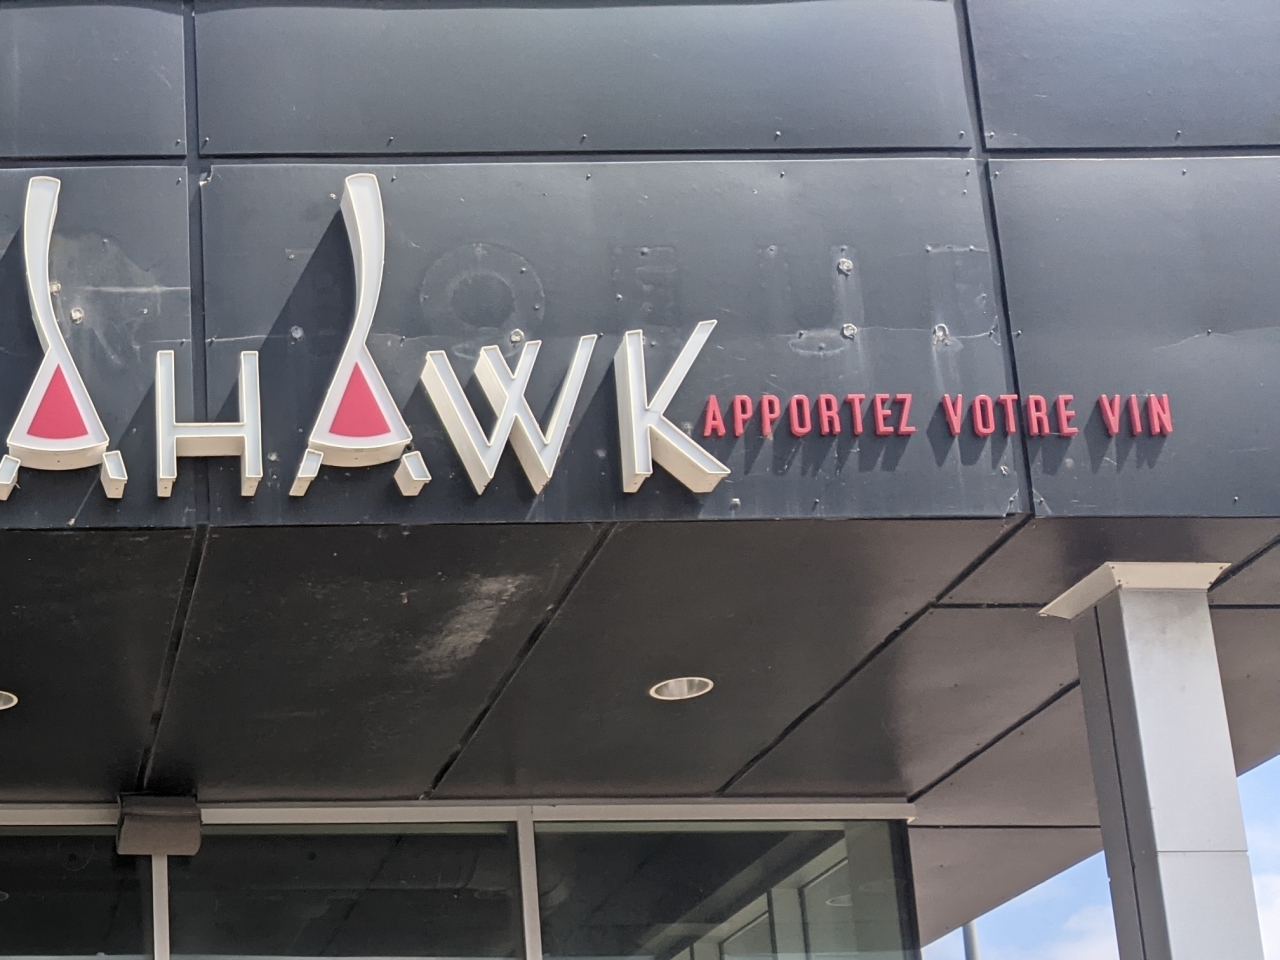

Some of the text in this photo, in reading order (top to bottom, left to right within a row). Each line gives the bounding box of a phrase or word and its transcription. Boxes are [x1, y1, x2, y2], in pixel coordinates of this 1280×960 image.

[703, 393, 1174, 438] APPORTEZ VOTRE VIN
